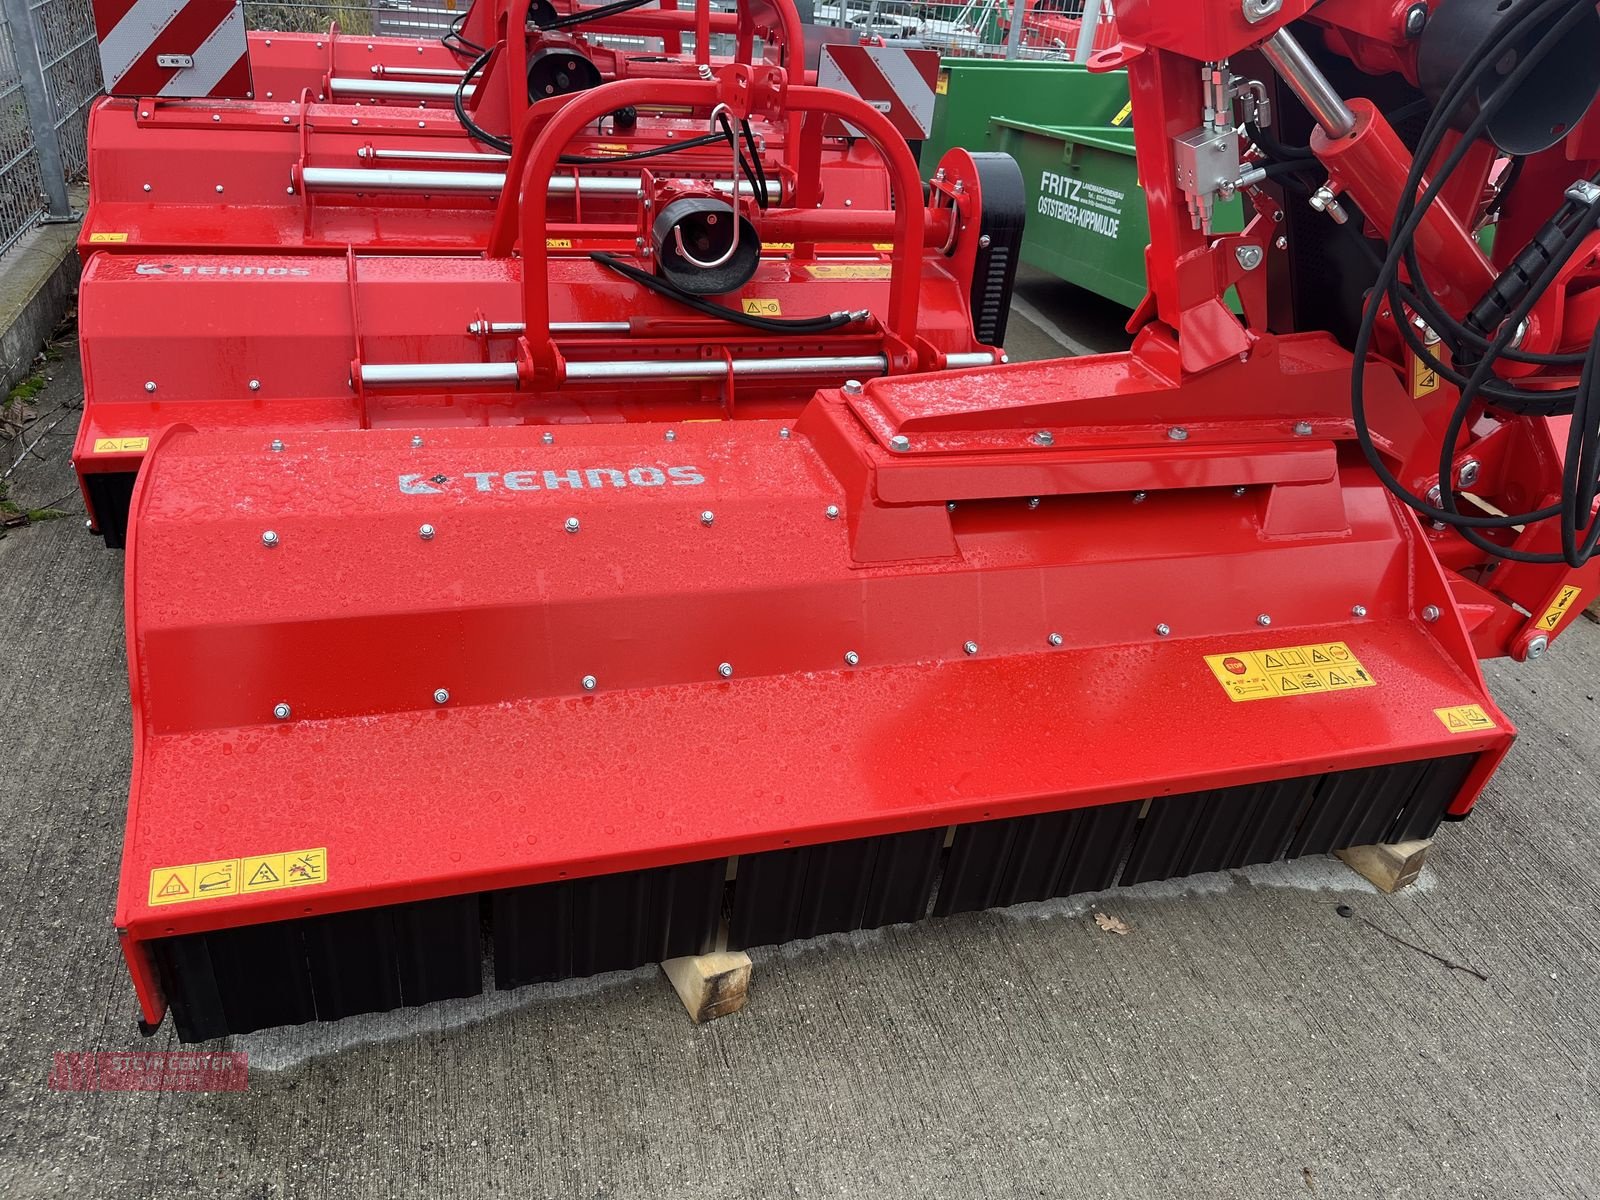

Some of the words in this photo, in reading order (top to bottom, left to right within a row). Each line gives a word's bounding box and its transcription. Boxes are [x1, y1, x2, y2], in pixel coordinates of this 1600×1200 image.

[1040, 171, 1082, 202] FRITZ
[1038, 195, 1120, 239] OSTSTEIRER-KIPPMULDE
[180, 266, 310, 276] TEHNOS
[464, 466, 705, 492] TEHNOS
[1226, 660, 1244, 670] STOP
